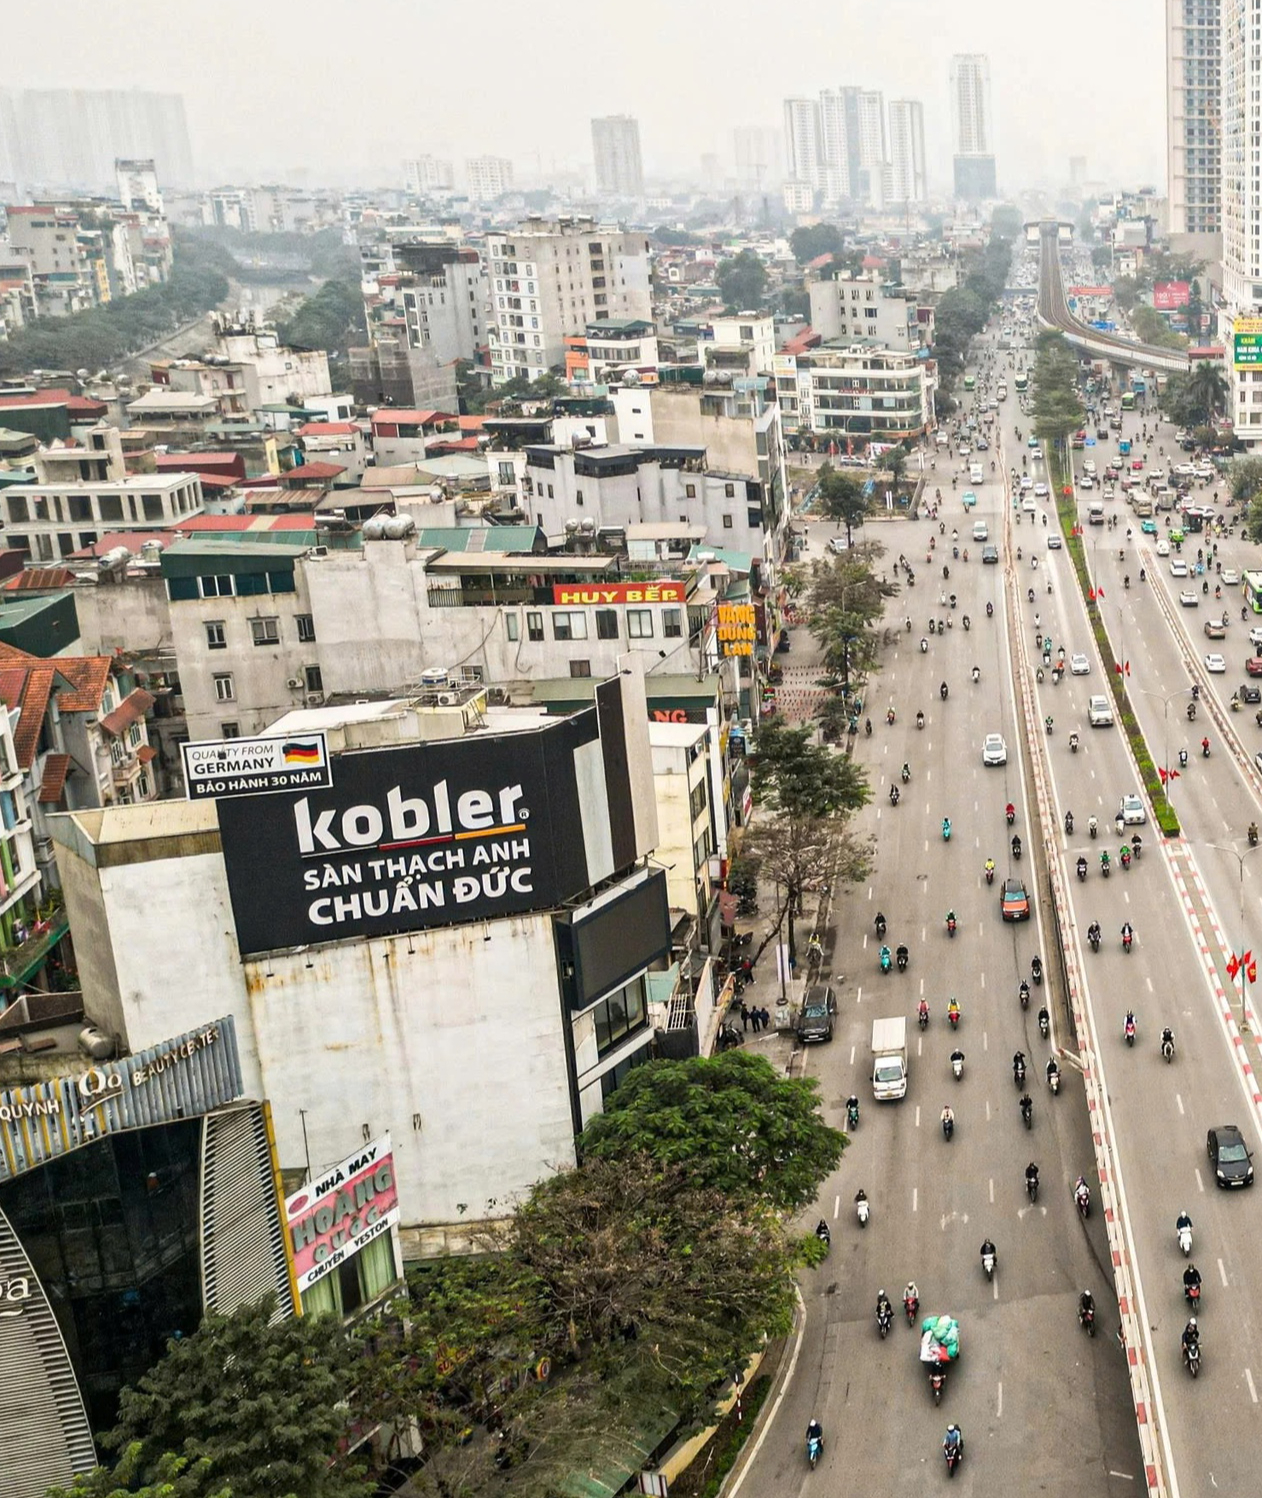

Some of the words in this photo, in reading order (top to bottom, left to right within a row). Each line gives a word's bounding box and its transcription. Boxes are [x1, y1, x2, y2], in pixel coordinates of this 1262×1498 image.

[561, 591, 618, 604] HUY
[192, 747, 240, 761] QUATY
[241, 744, 274, 756] FROM
[194, 757, 274, 775] GERMANY
[196, 780, 226, 794] BẢO
[229, 777, 268, 790] HÀNH
[272, 775, 288, 786] 30
[290, 771, 322, 784] NĂM
[293, 779, 524, 853] kobler
[303, 863, 362, 890] SÀN
[368, 848, 465, 880] THẠCH
[472, 838, 531, 866] ANH
[308, 876, 445, 925] CHUẨN
[452, 864, 533, 904] ĐỨC
[133, 1052, 179, 1087] BEAUTY
[315, 1168, 345, 1198] NHÀ
[348, 1147, 377, 1176] MAY
[292, 1164, 393, 1254] HOÀNG
[307, 1249, 345, 1283] CHUYÊN
[0, 1277, 32, 1302] a
